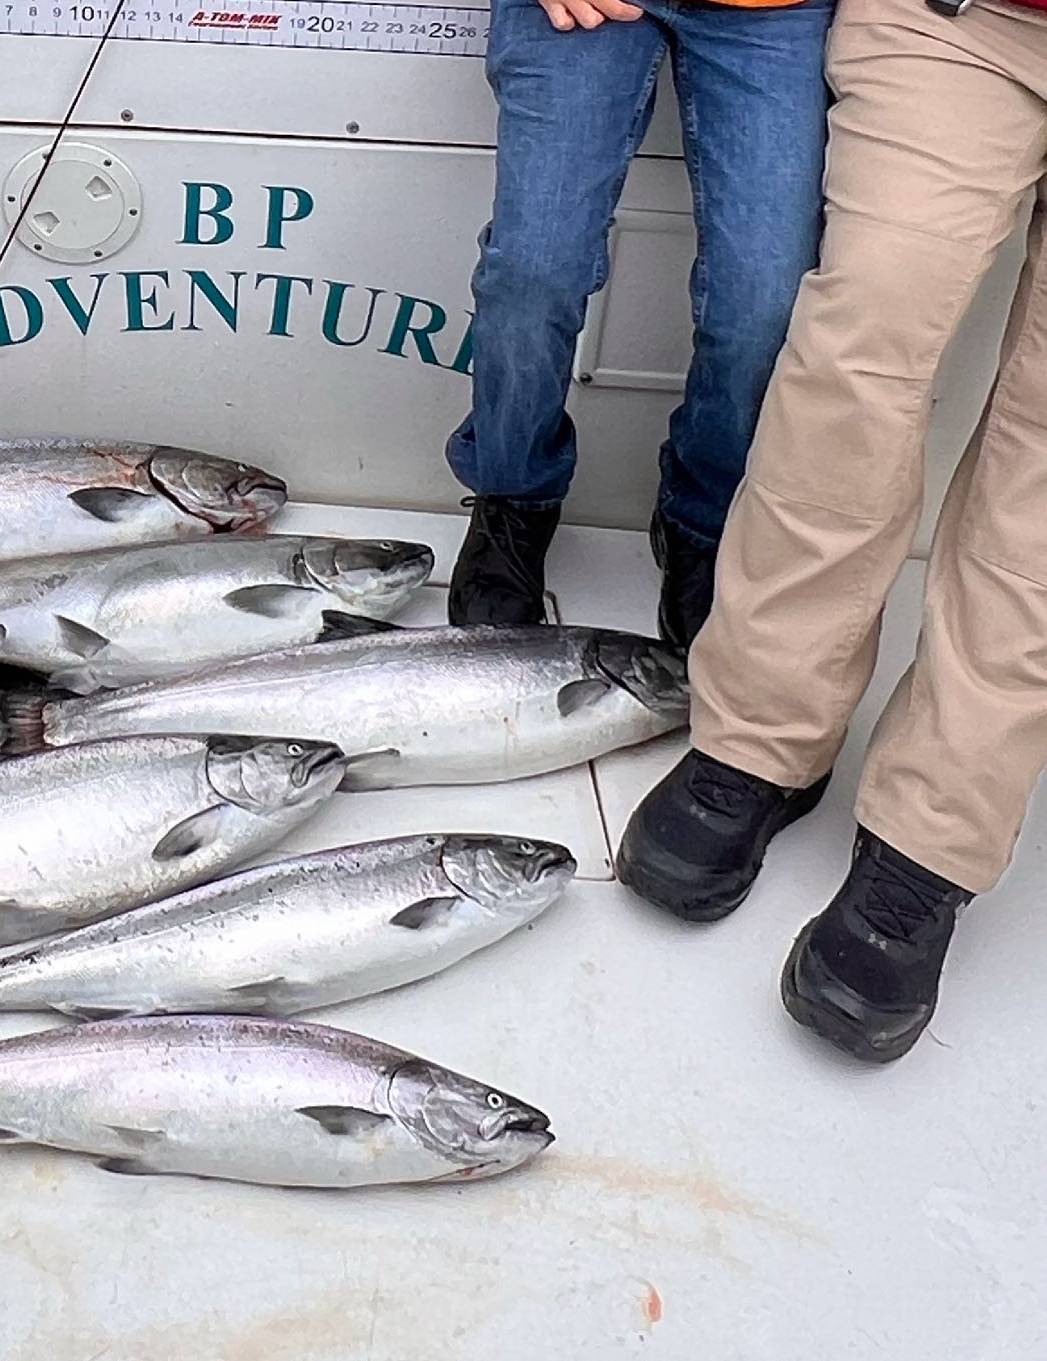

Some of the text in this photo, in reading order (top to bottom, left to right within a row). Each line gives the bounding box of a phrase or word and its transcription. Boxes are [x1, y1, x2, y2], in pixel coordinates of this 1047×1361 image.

[5, 5, 14, 16] 7
[29, 6, 38, 17] 8
[53, 7, 62, 18] 9
[70, 6, 95, 21] 10
[97, 9, 110, 20] 11
[121, 10, 137, 21] 12
[145, 11, 161, 22] 13
[168, 12, 184, 23] 14
[290, 18, 306, 29] 19
[307, 16, 335, 33] 20
[336, 20, 353, 31] 21
[360, 21, 379, 33] 22
[385, 23, 403, 34] 23
[409, 24, 426, 35] 24
[428, 22, 457, 39] 25
[459, 26, 476, 38] 26
